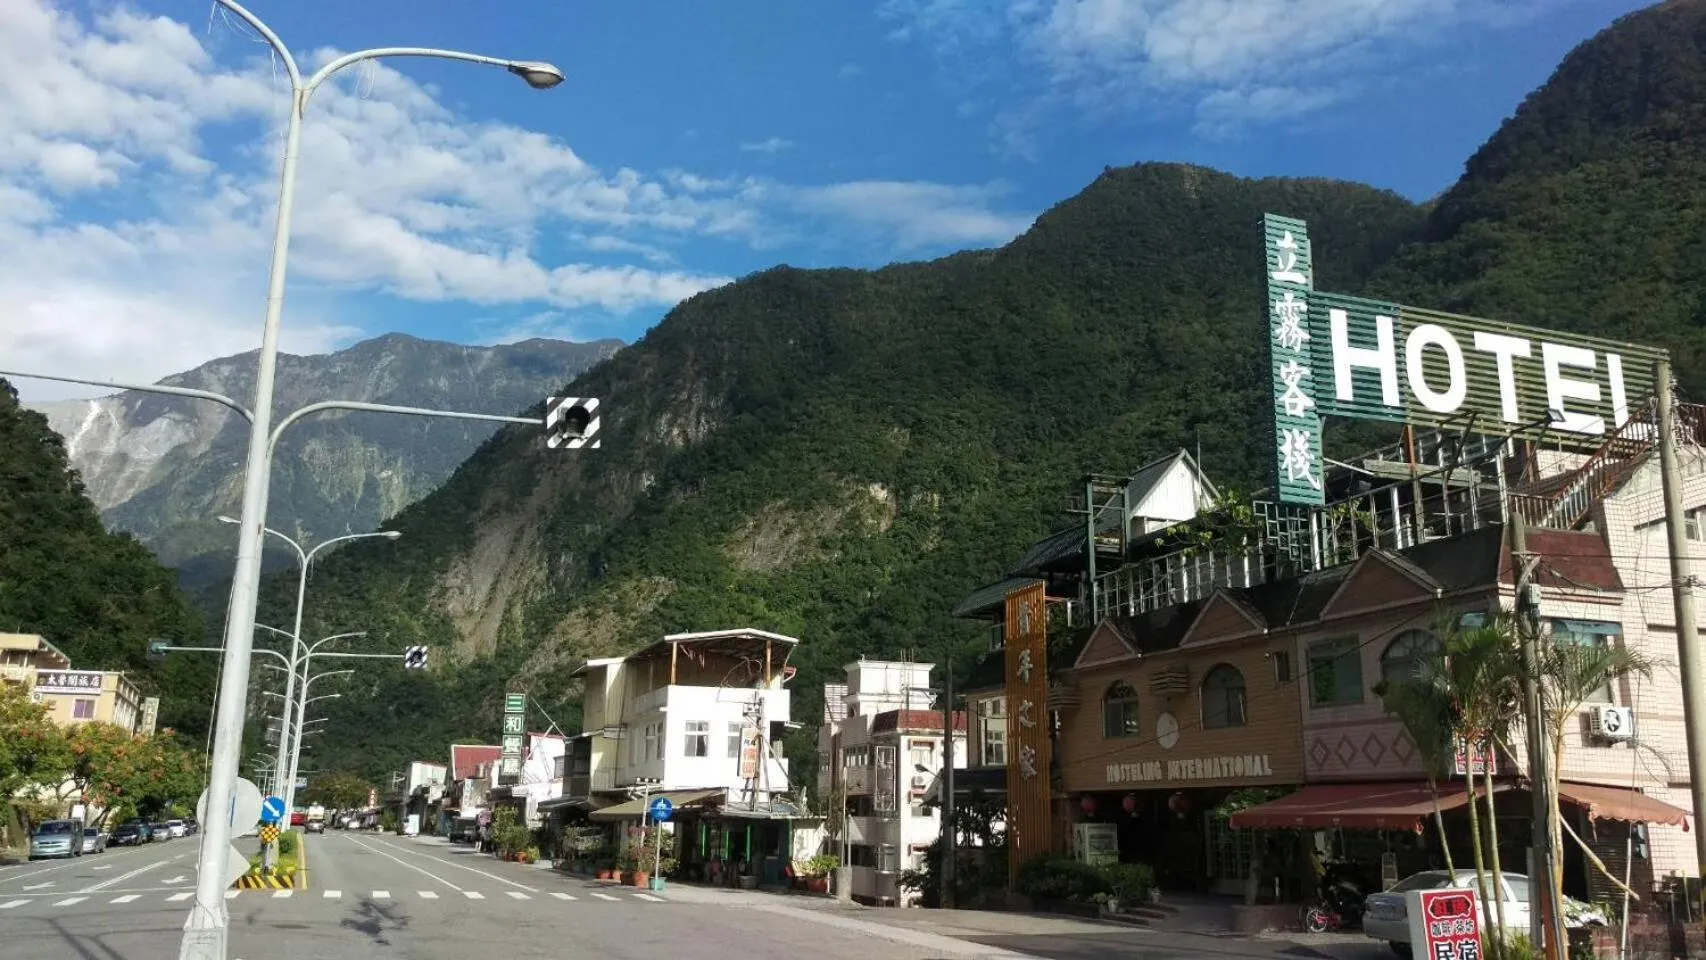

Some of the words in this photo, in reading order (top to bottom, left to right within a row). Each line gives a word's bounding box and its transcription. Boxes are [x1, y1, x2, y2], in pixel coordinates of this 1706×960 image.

[1271, 231, 1321, 490] 立霧客棧
[1330, 308, 1630, 435] HOTEL
[1167, 754, 1272, 781] INTERNATIONAL
[1434, 939, 1478, 960] 民宿
